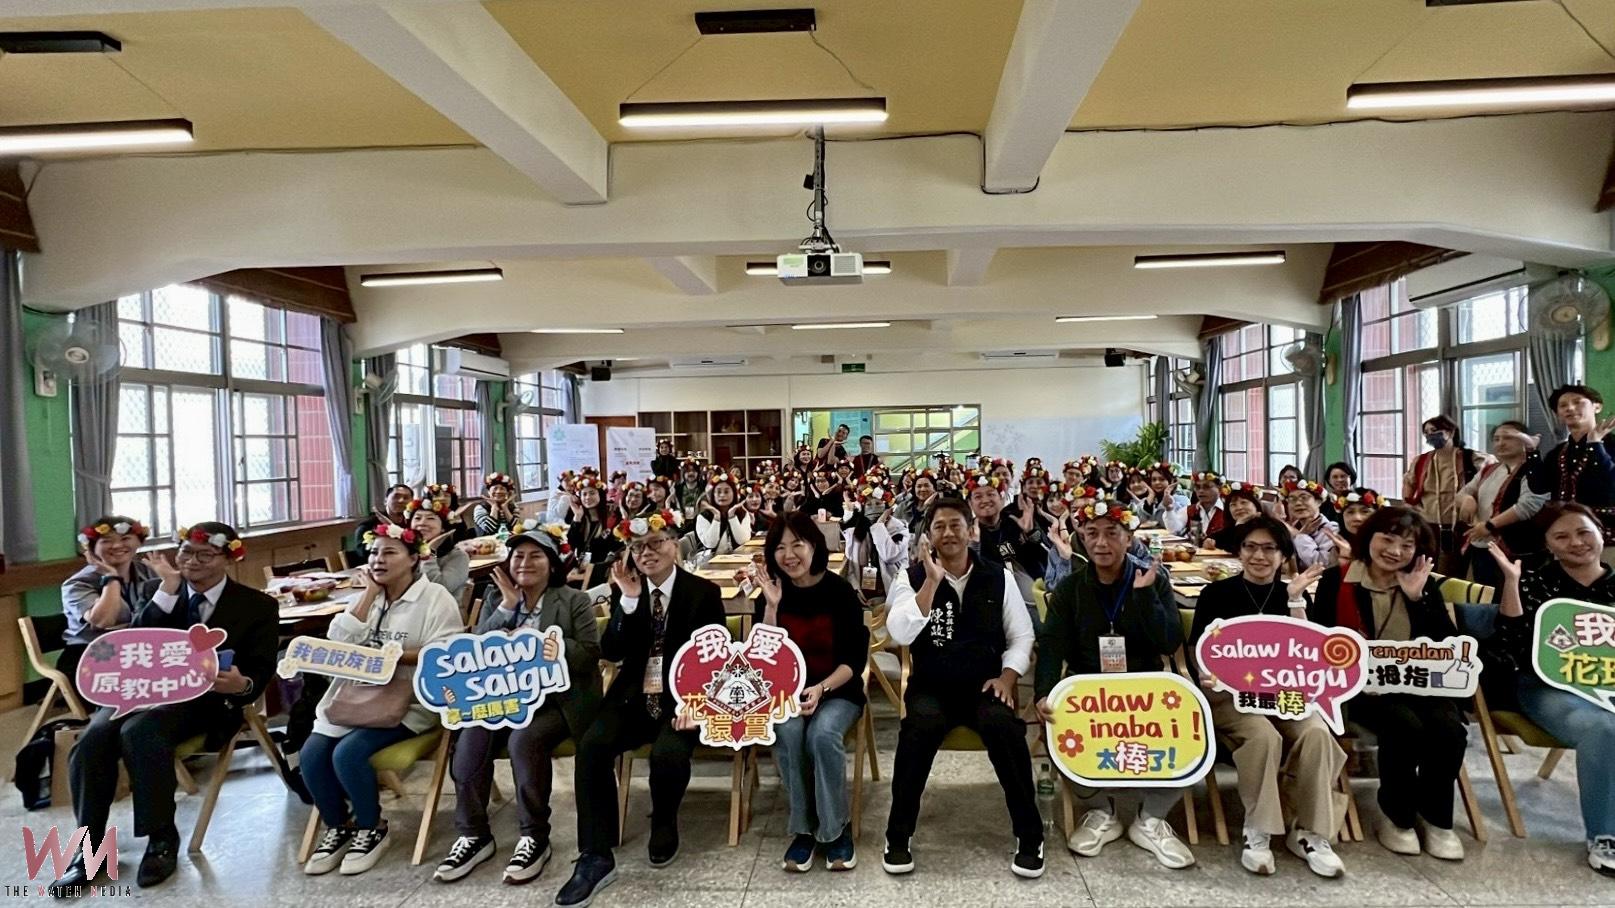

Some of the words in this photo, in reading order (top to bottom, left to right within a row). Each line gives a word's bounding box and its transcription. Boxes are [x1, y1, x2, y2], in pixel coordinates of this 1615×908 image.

[1575, 612, 1615, 647] 我
[119, 640, 192, 669] 我愛
[436, 636, 537, 678] salaw
[1210, 638, 1281, 659] salaw
[1288, 638, 1319, 662] ku
[91, 669, 206, 700] 原教中心
[465, 663, 565, 704] saigu
[1260, 664, 1348, 697] saigu
[1065, 687, 1154, 713] salaw
[1238, 689, 1306, 715] 我最棒
[1096, 740, 1176, 775] 太棒了!
